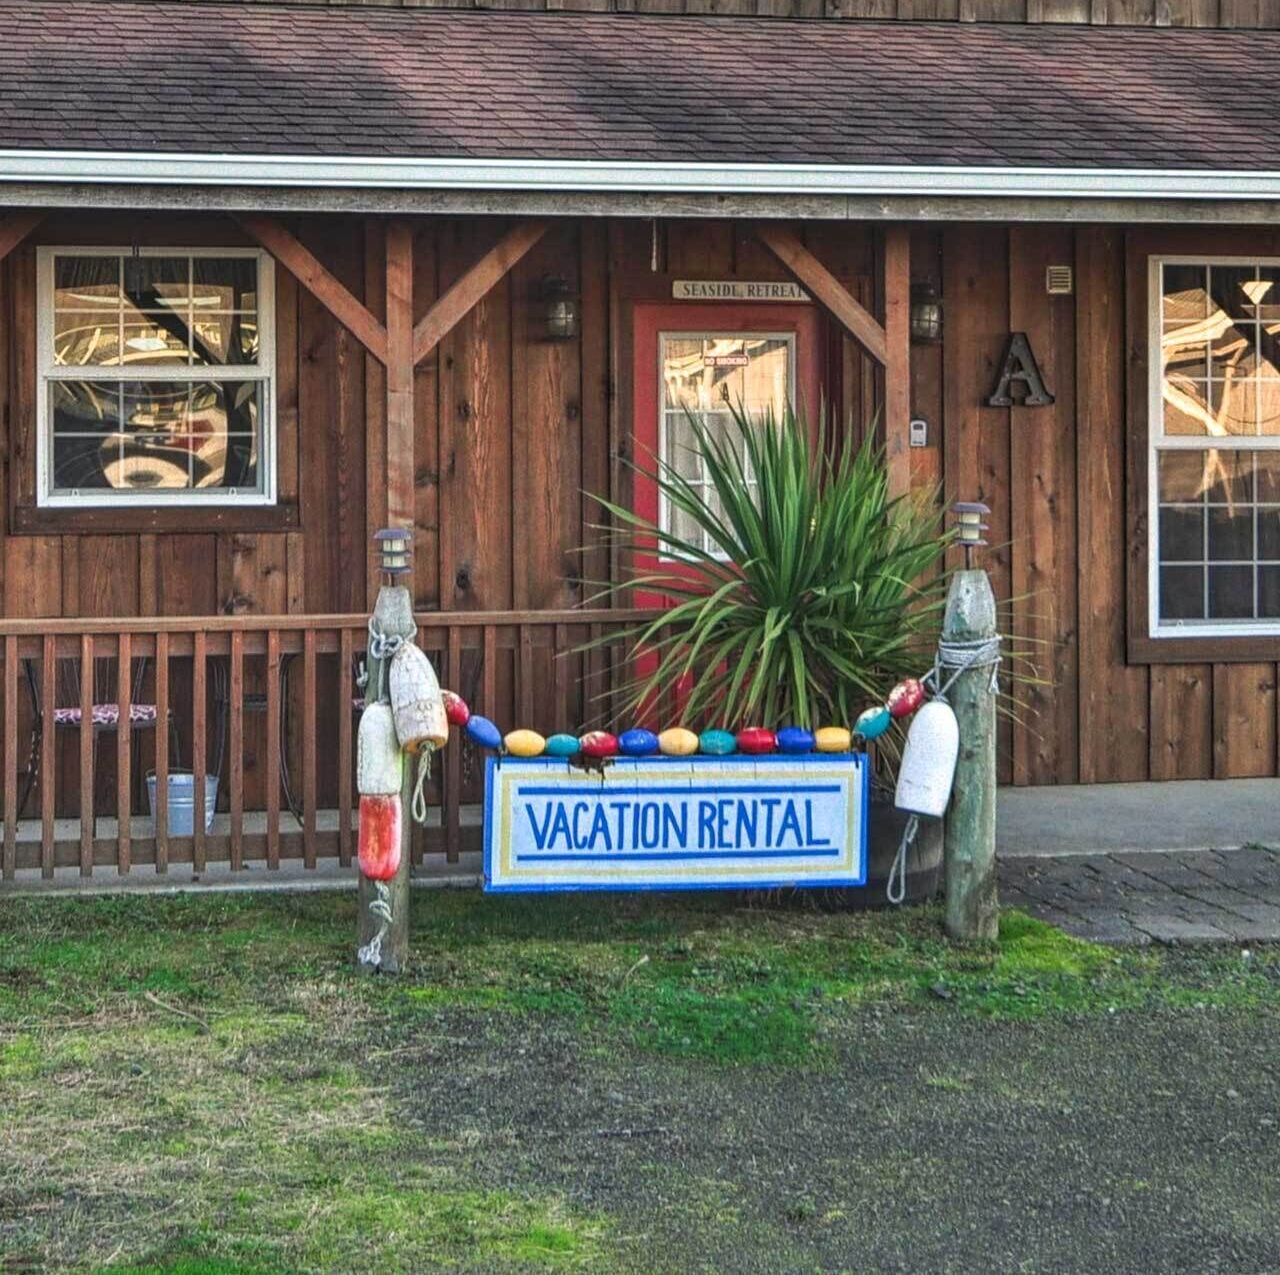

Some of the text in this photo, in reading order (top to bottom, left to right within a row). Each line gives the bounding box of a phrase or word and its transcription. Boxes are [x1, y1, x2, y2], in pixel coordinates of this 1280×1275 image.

[683, 284, 740, 297] SEASIDE
[984, 331, 1055, 407] A
[525, 798, 830, 851] VACATION RENTAL
